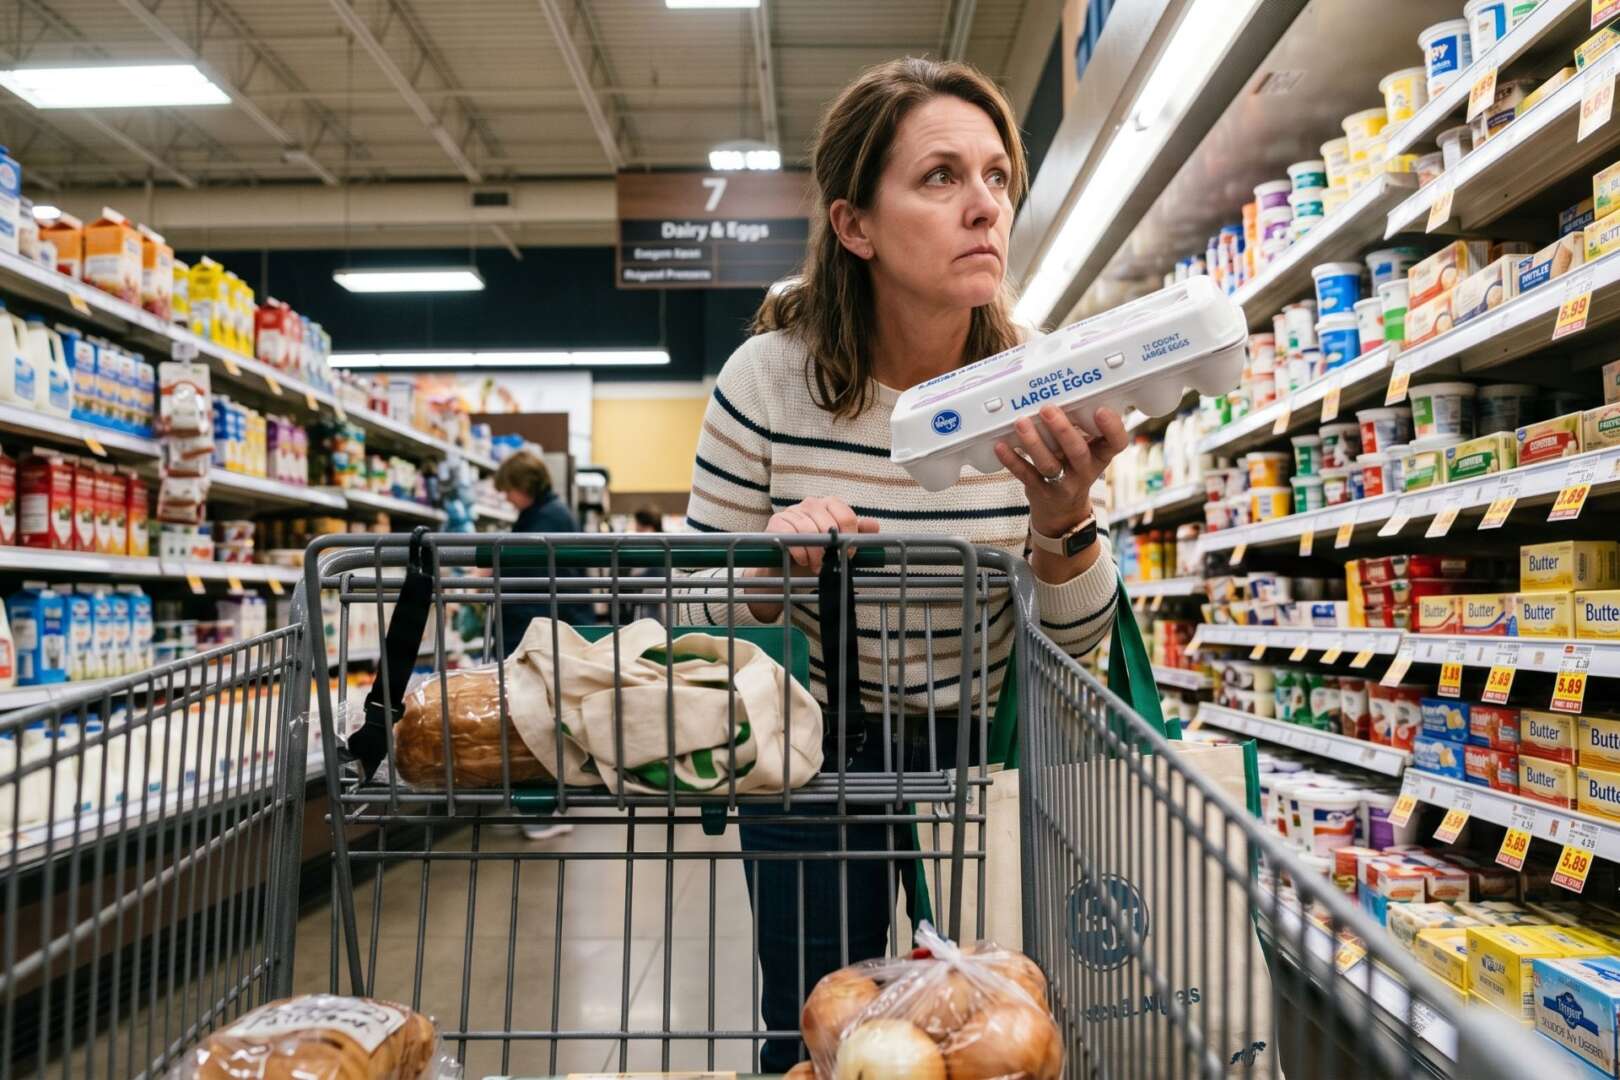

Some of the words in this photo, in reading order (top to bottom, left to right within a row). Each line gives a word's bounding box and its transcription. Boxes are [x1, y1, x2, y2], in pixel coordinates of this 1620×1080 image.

[702, 177, 728, 212] 7
[661, 222, 708, 242] Dairy
[710, 221, 724, 239] &
[726, 221, 770, 242] Eggs
[1141, 349, 1168, 362] LARGE
[1167, 338, 1191, 352] EGGS
[1028, 370, 1065, 389] GRADE
[1066, 367, 1075, 377] A
[1011, 383, 1061, 411] LARGE
[1062, 368, 1103, 392] EGGS
[1529, 555, 1560, 572] Butter
[1424, 604, 1448, 617] Butter
[1468, 603, 1496, 618] Butter
[1523, 603, 1556, 621] Butter
[1557, 677, 1582, 694] 5.89
[1530, 720, 1560, 740] Butter
[1591, 727, 1620, 750] Butt
[1527, 766, 1556, 788] Butter
[1505, 833, 1527, 853] 5.89
[1562, 852, 1588, 874] 5.89
